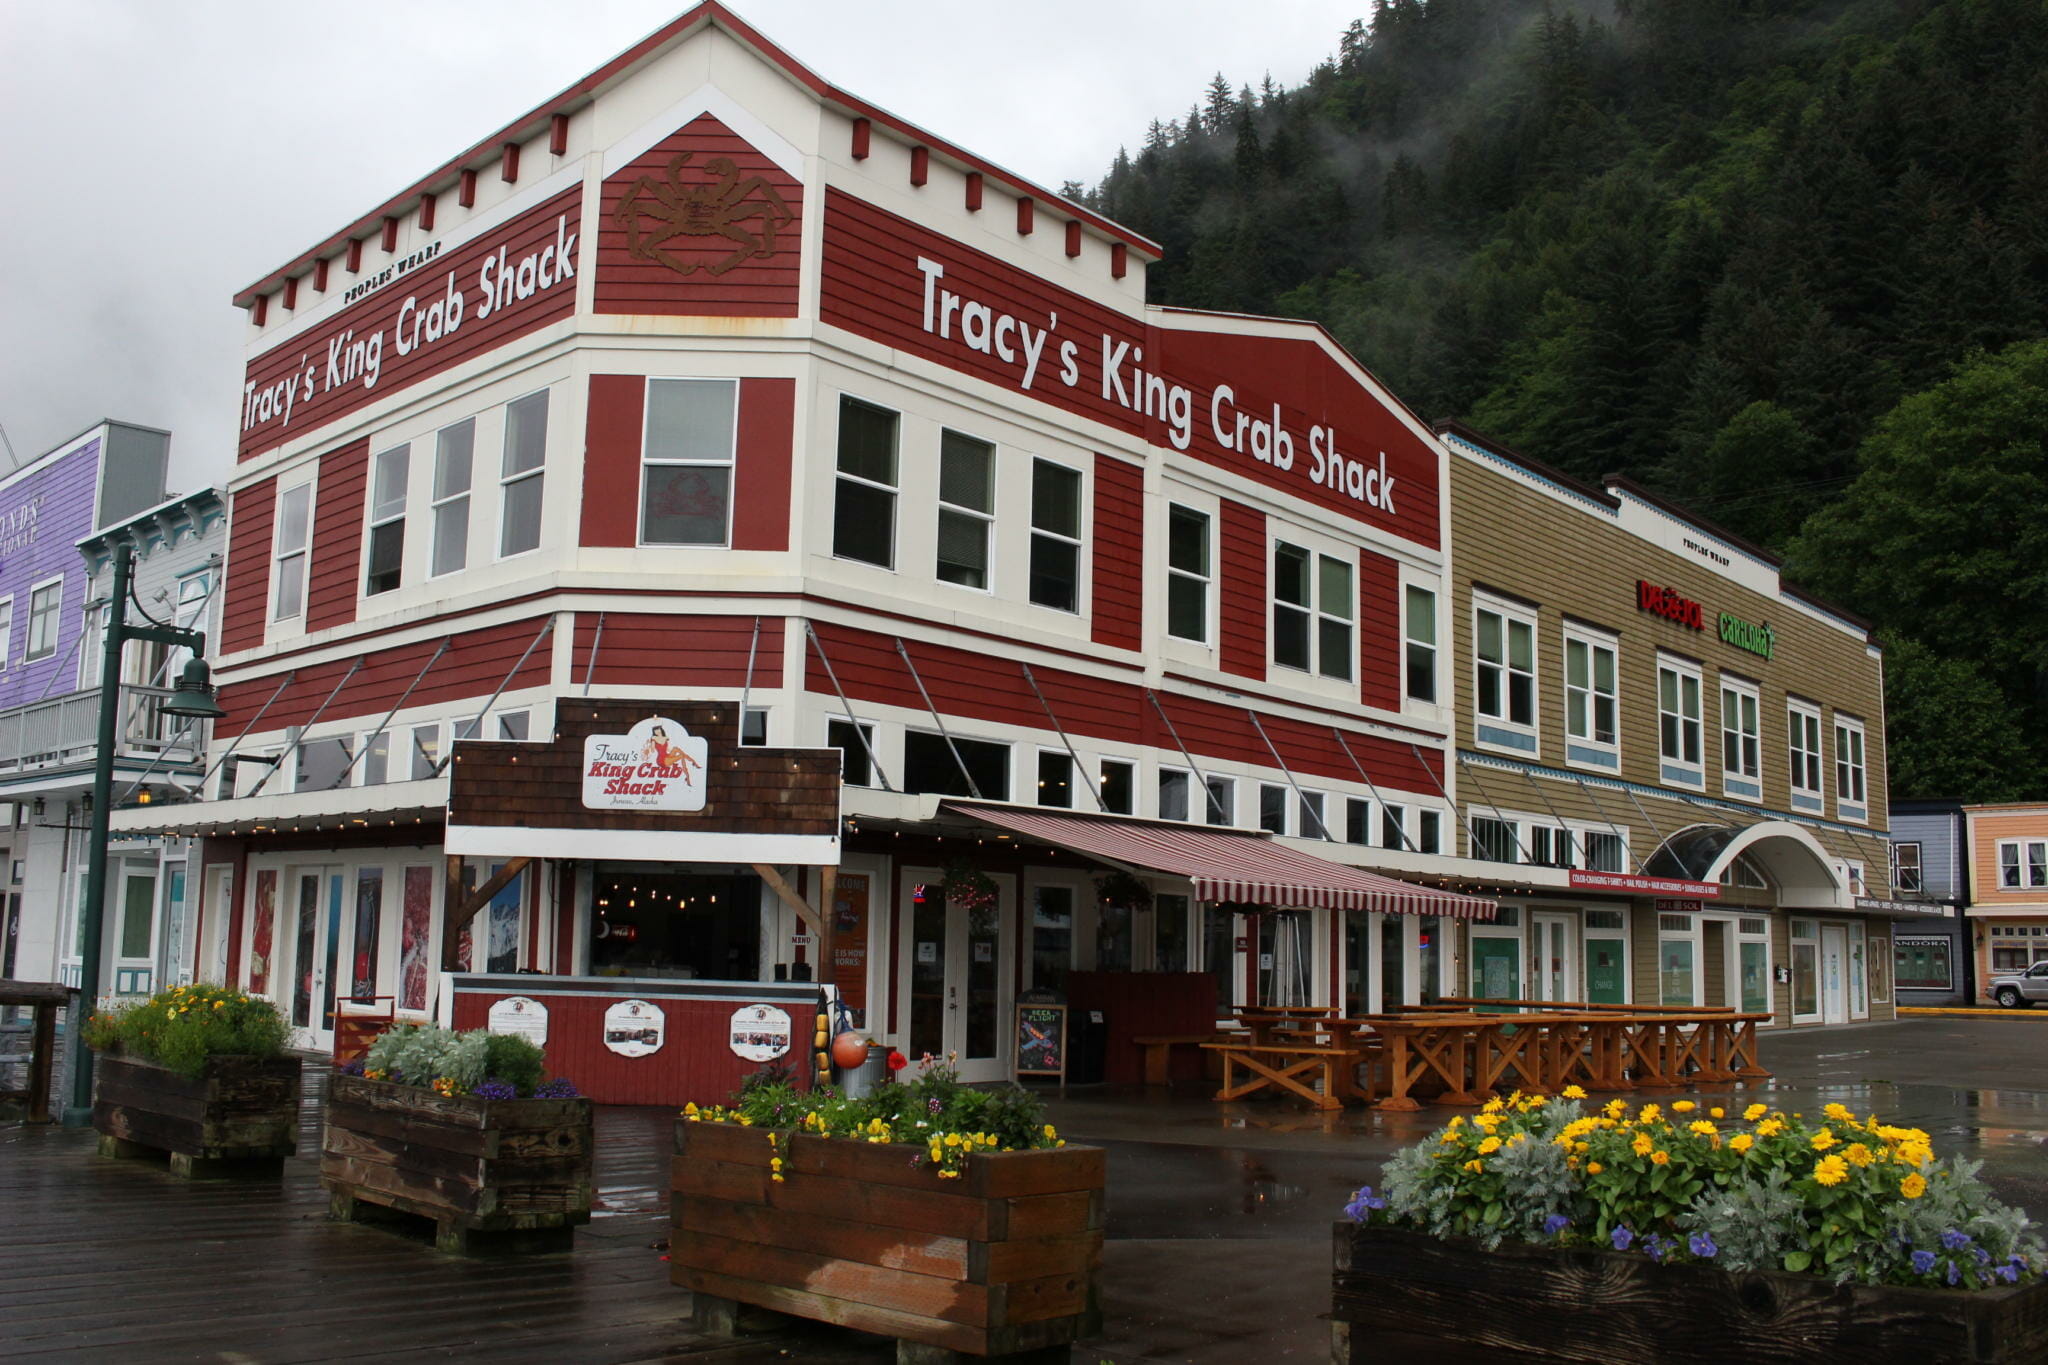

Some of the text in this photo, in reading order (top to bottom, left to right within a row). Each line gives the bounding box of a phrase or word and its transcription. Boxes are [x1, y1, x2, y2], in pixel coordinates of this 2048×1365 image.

[344, 241, 442, 304] PEOPLES' WHARF
[243, 214, 577, 431] Tracy's King Crab Shack
[917, 255, 1396, 514] Tracy's King Crab Shack
[588, 762, 682, 781] King Crab
[593, 743, 639, 765] Tracy's
[604, 779, 667, 795] Shack
